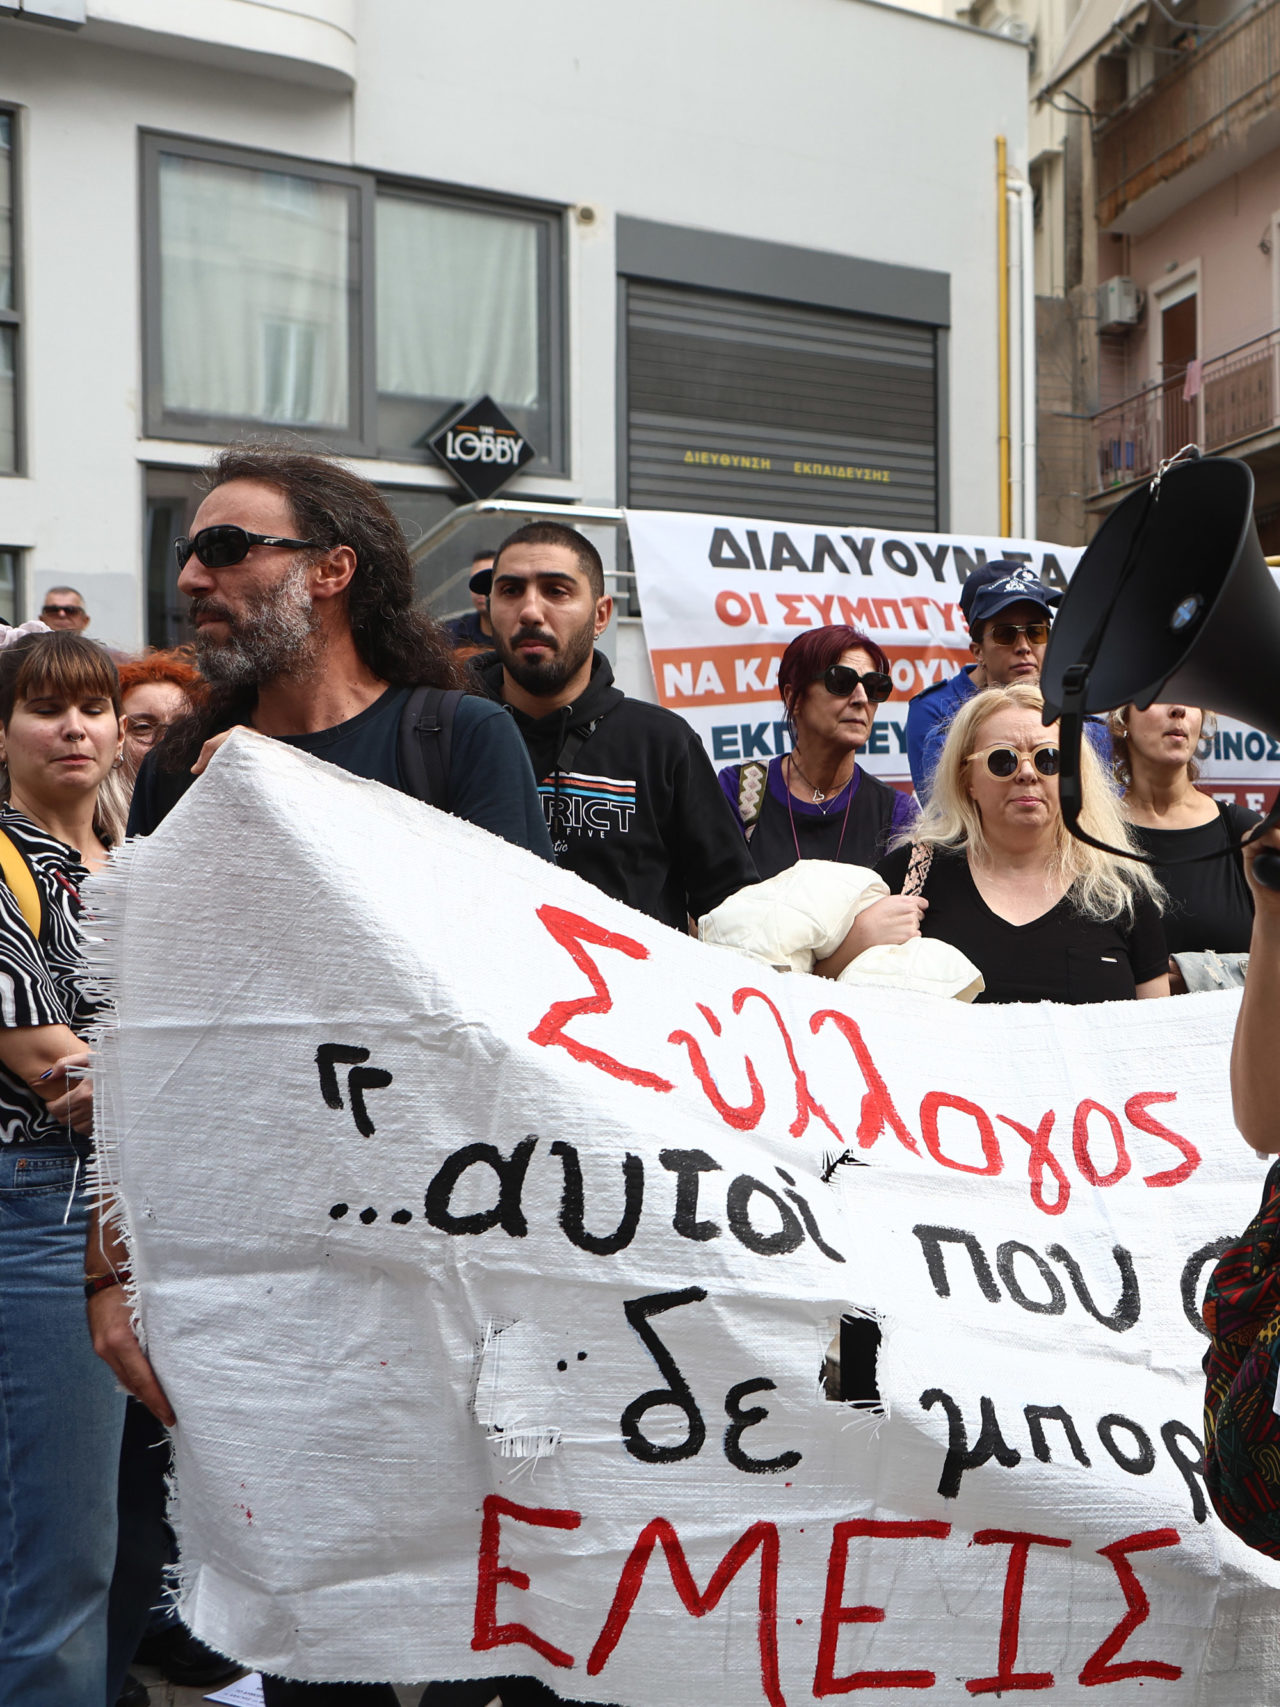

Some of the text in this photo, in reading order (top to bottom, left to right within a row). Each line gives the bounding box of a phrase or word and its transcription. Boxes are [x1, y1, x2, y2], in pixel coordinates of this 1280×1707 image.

[446, 431, 524, 465] LOBBY
[683, 450, 890, 483] ΔΙΕΥΘΥΝΣΗ ΕΚΠΑΙΔΕΥΣΗΣ
[715, 590, 768, 626] ΟΙ
[775, 593, 970, 634] ΣΥΜΠΤΥ
[662, 660, 725, 697] ΝΑ
[538, 794, 636, 832] RICT
[529, 904, 1201, 1215] Σύλλογος
[913, 1224, 1140, 1333] που
[621, 1286, 802, 1475] δε
[920, 1387, 1210, 1524] μπορ
[471, 1495, 1182, 1707] ΕΜΕΙΣ
